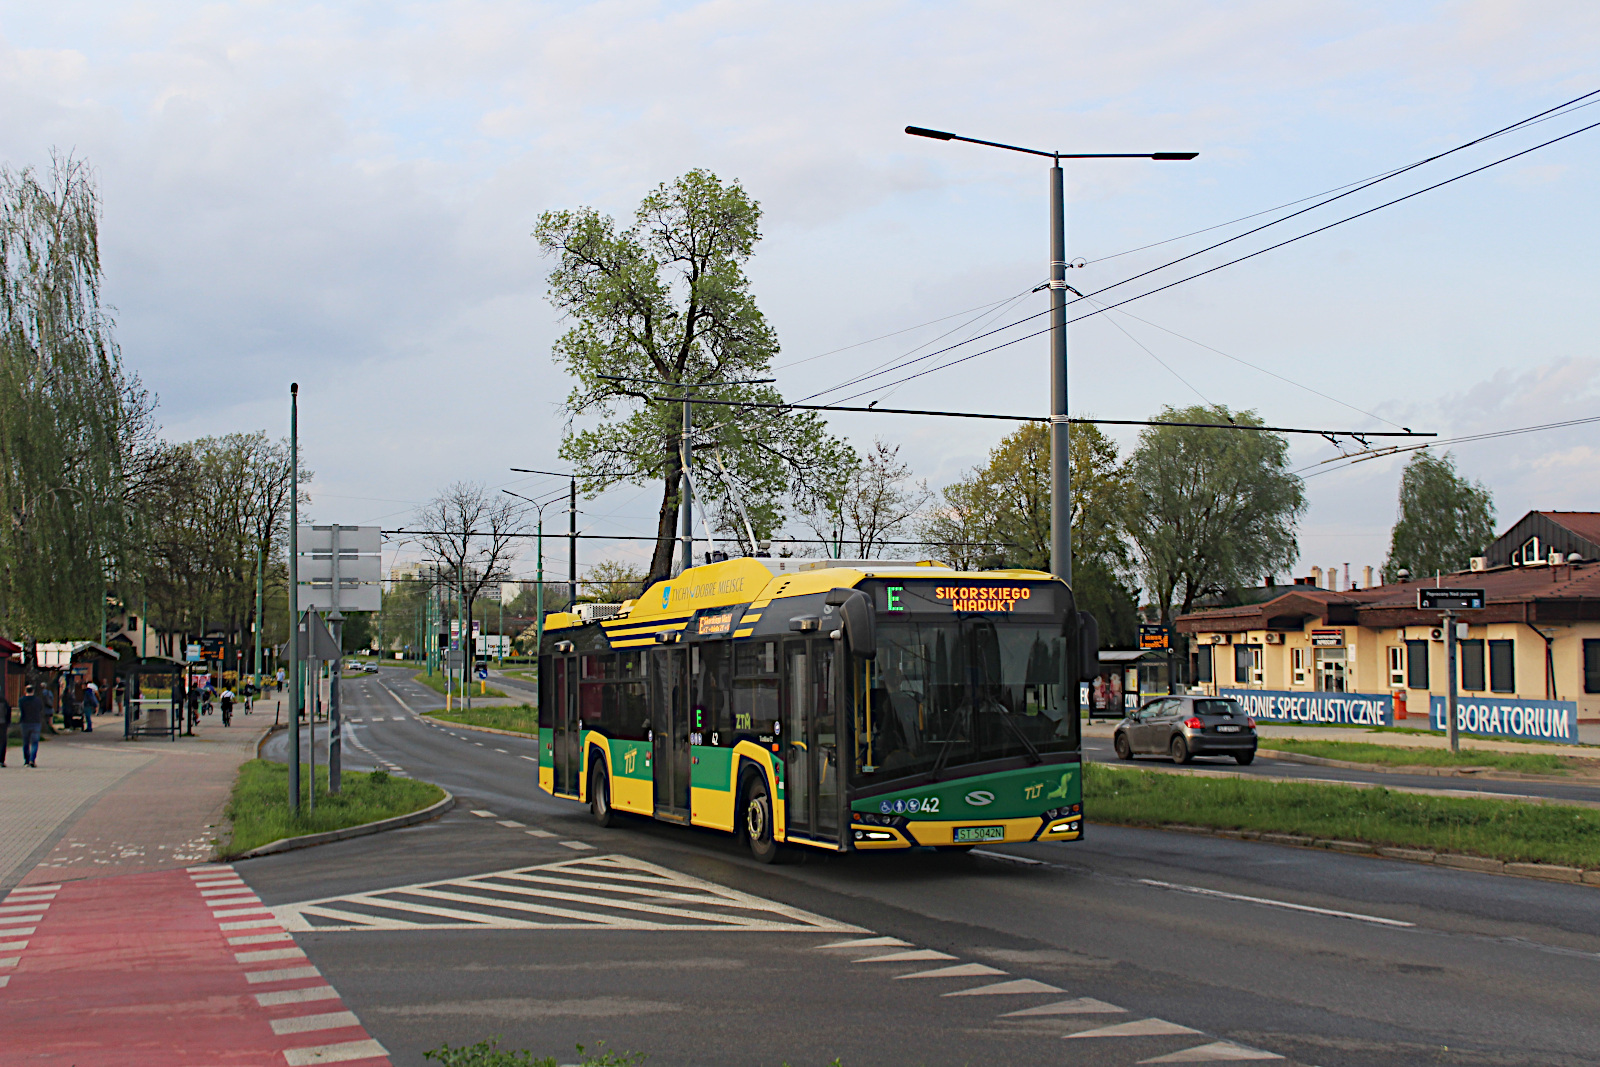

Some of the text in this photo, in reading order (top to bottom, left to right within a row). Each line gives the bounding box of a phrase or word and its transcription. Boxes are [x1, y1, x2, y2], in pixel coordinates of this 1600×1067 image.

[671, 577, 745, 602] TYCHY DOBRE MIEJSCE
[886, 586, 1031, 611] E SIKORSKIEGO
[952, 599, 1017, 612] WIADUKT
[696, 709, 702, 728] E
[735, 712, 751, 730] ZTM
[1277, 697, 1386, 727] SPECJALISTYCZNE
[1436, 703, 1570, 739] LBORATORIUM
[711, 732, 719, 746] 42
[1024, 784, 1044, 800] TLT
[920, 797, 940, 813] 42
[960, 828, 1002, 840] ST 5042N
